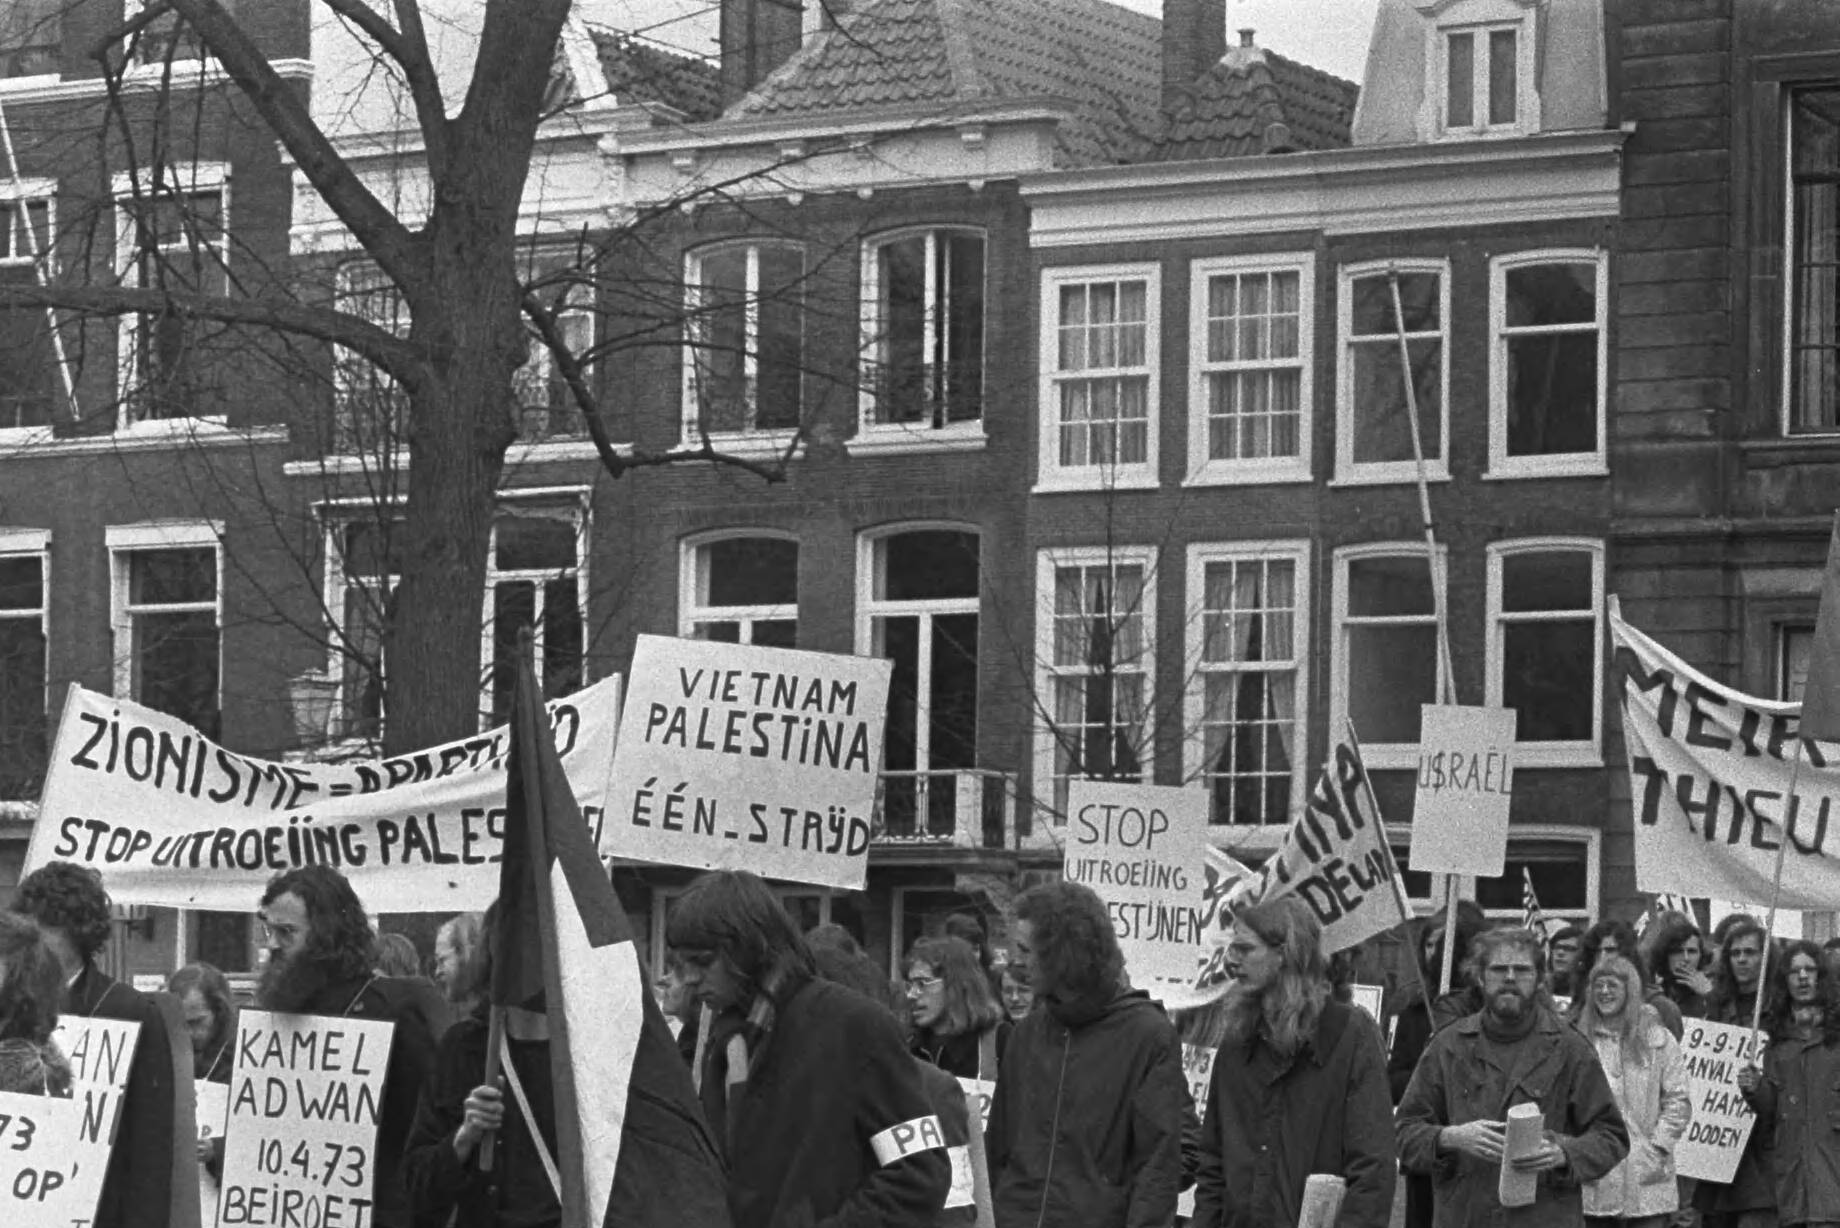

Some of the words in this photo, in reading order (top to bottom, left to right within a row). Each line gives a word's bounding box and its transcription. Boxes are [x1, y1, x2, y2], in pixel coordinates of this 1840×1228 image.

[680, 667, 857, 716] VIETNAM
[55, 816, 152, 863] STOP
[1078, 804, 1169, 850] STOP
[240, 1028, 371, 1075] KAMEL
[1683, 1054, 1733, 1084] ANVAL
[233, 1077, 384, 1125] ADWAN
[1688, 1121, 1742, 1148] DODEN
[12, 1167, 65, 1201] OP
[257, 1139, 366, 1187] 10.4.73
